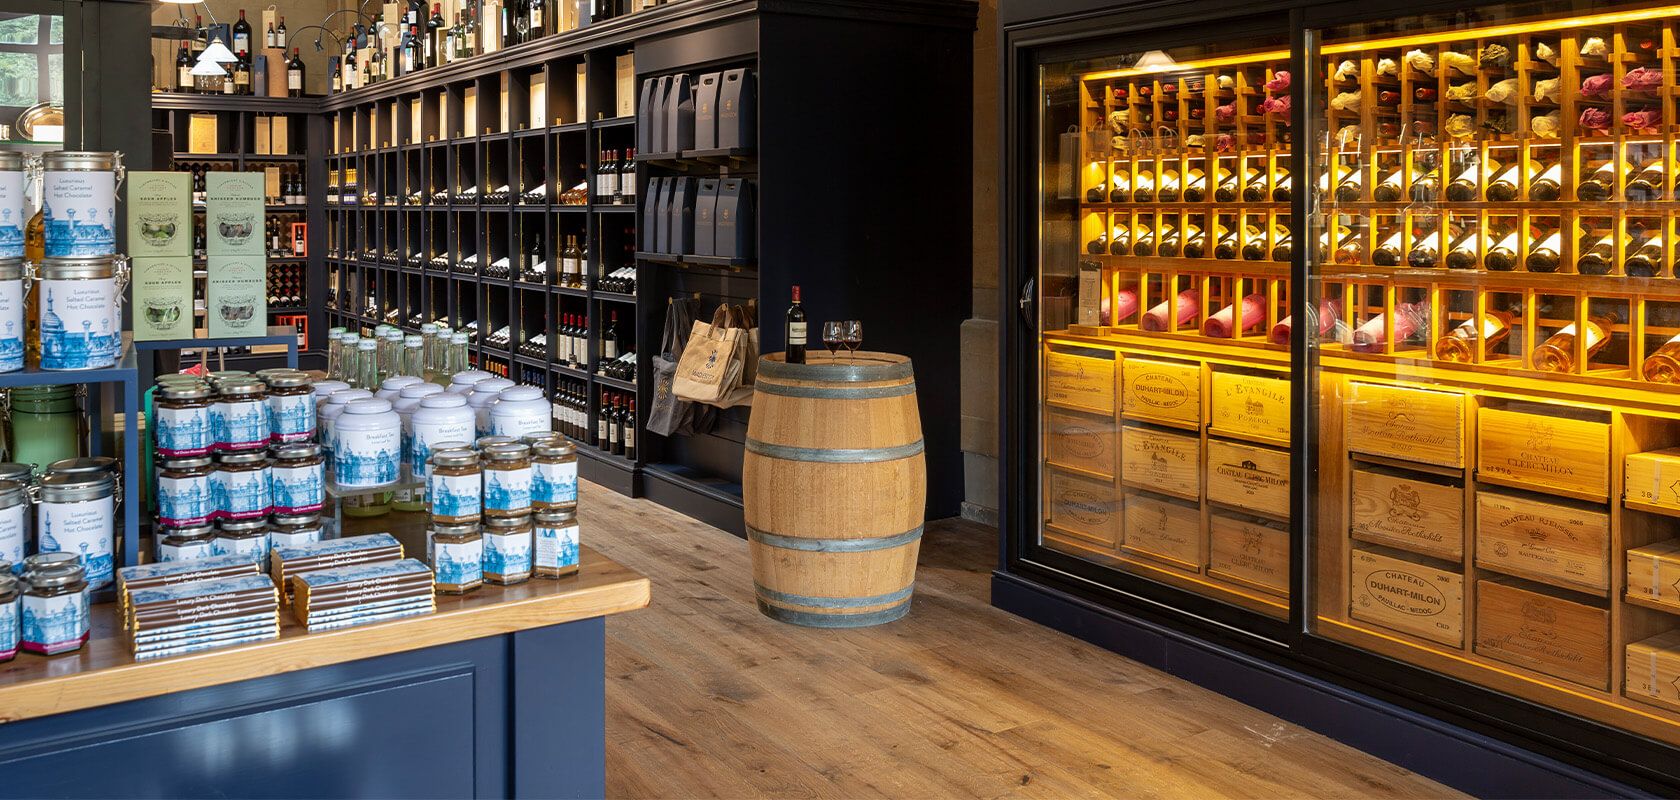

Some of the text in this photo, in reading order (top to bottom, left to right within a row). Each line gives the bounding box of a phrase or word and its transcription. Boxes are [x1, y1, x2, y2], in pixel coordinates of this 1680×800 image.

[1500, 514, 1535, 528] CHATEAU
[1385, 572, 1425, 588] CHATEAU
[1370, 580, 1440, 606] DUHART-MILON
[1378, 594, 1406, 611] PAUILLAC
